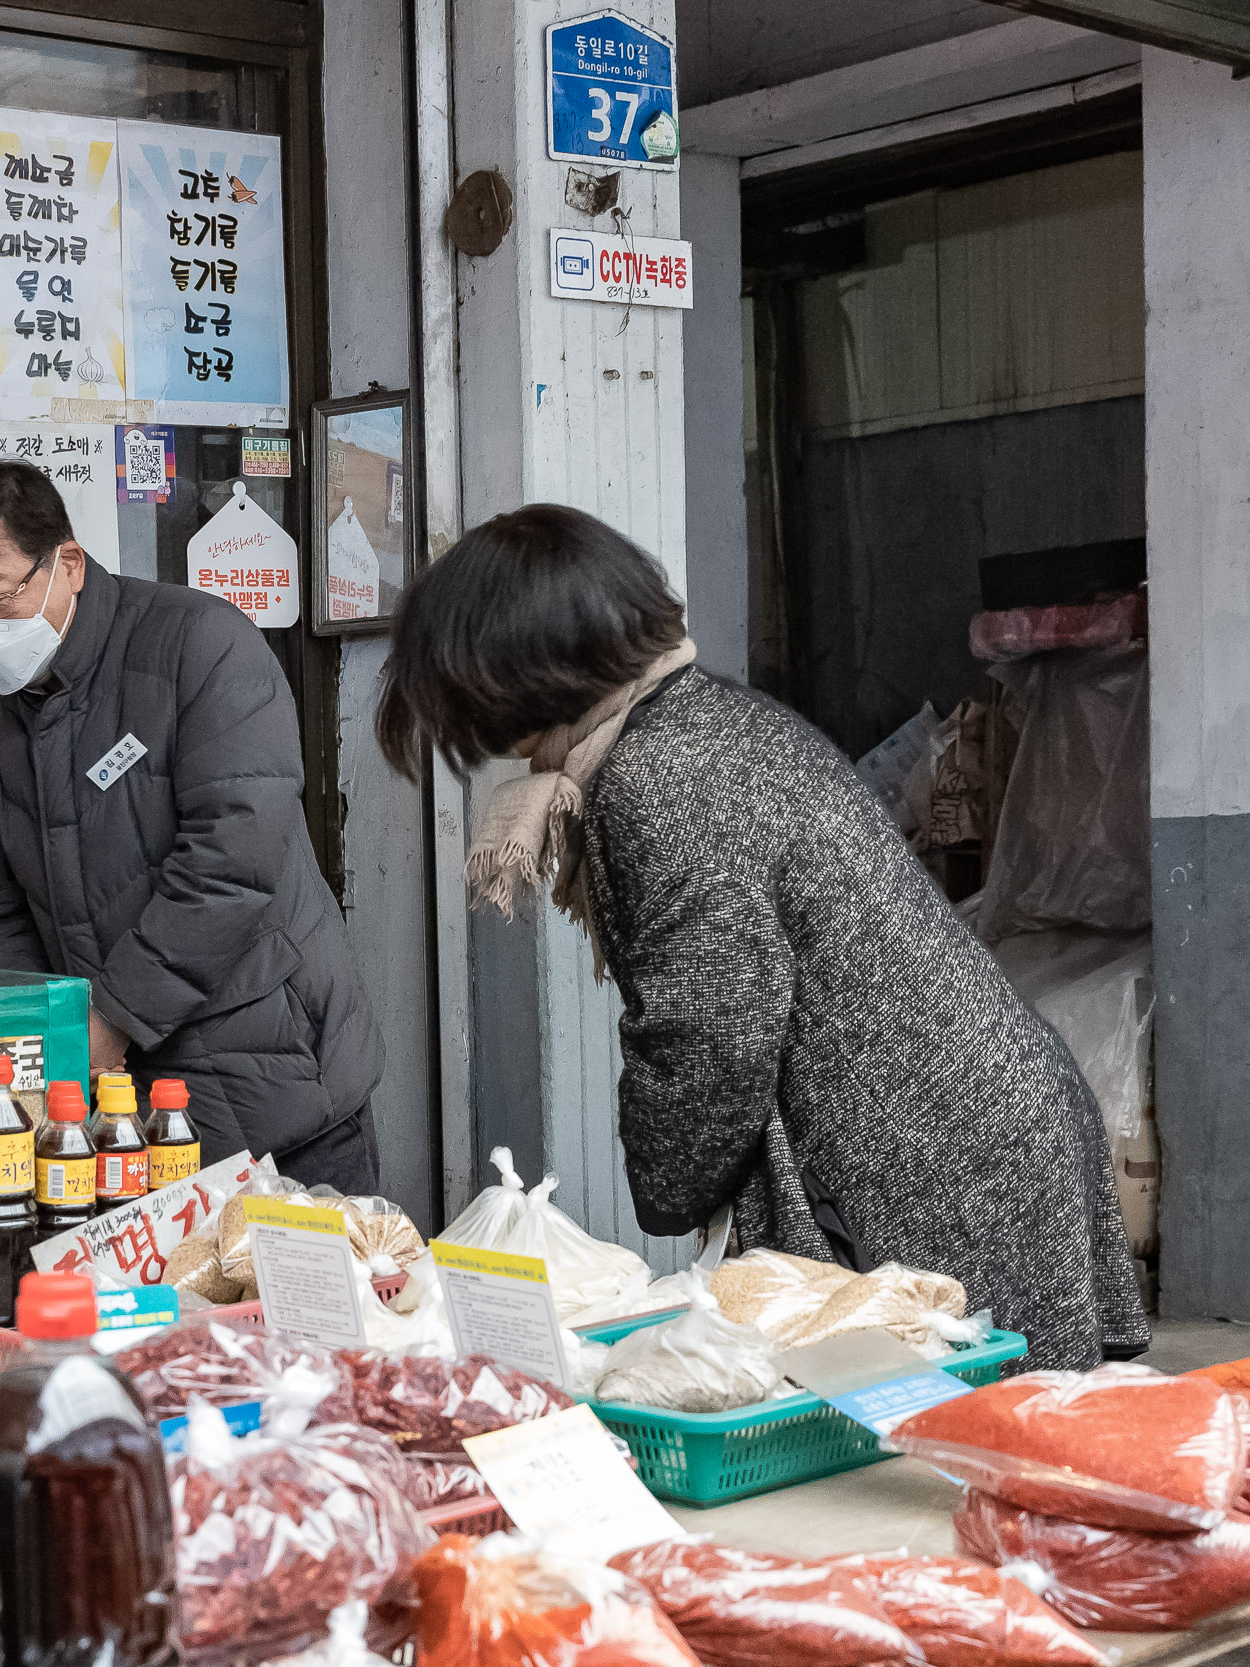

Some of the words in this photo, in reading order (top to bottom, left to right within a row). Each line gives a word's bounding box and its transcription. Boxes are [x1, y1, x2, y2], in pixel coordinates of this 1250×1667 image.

[575, 35, 648, 65] 동일로10길
[578, 59, 620, 75] Dongil-ro
[623, 65, 648, 80] 10-gil
[587, 87, 639, 144] 37
[3, 152, 75, 187] 깨소금
[178, 168, 221, 204] 고추
[166, 208, 239, 250] 참기름
[169, 255, 239, 295] 들기름
[13, 309, 81, 342] 누룽지
[184, 301, 232, 338] 소금
[25, 349, 73, 382] 마늘
[183, 345, 235, 383] 잡곡
[52, 435, 90, 456] 도소매
[55, 463, 94, 485] 새우젓
[197, 568, 291, 588] 온누리상품권
[222, 591, 269, 610] 가맹점
